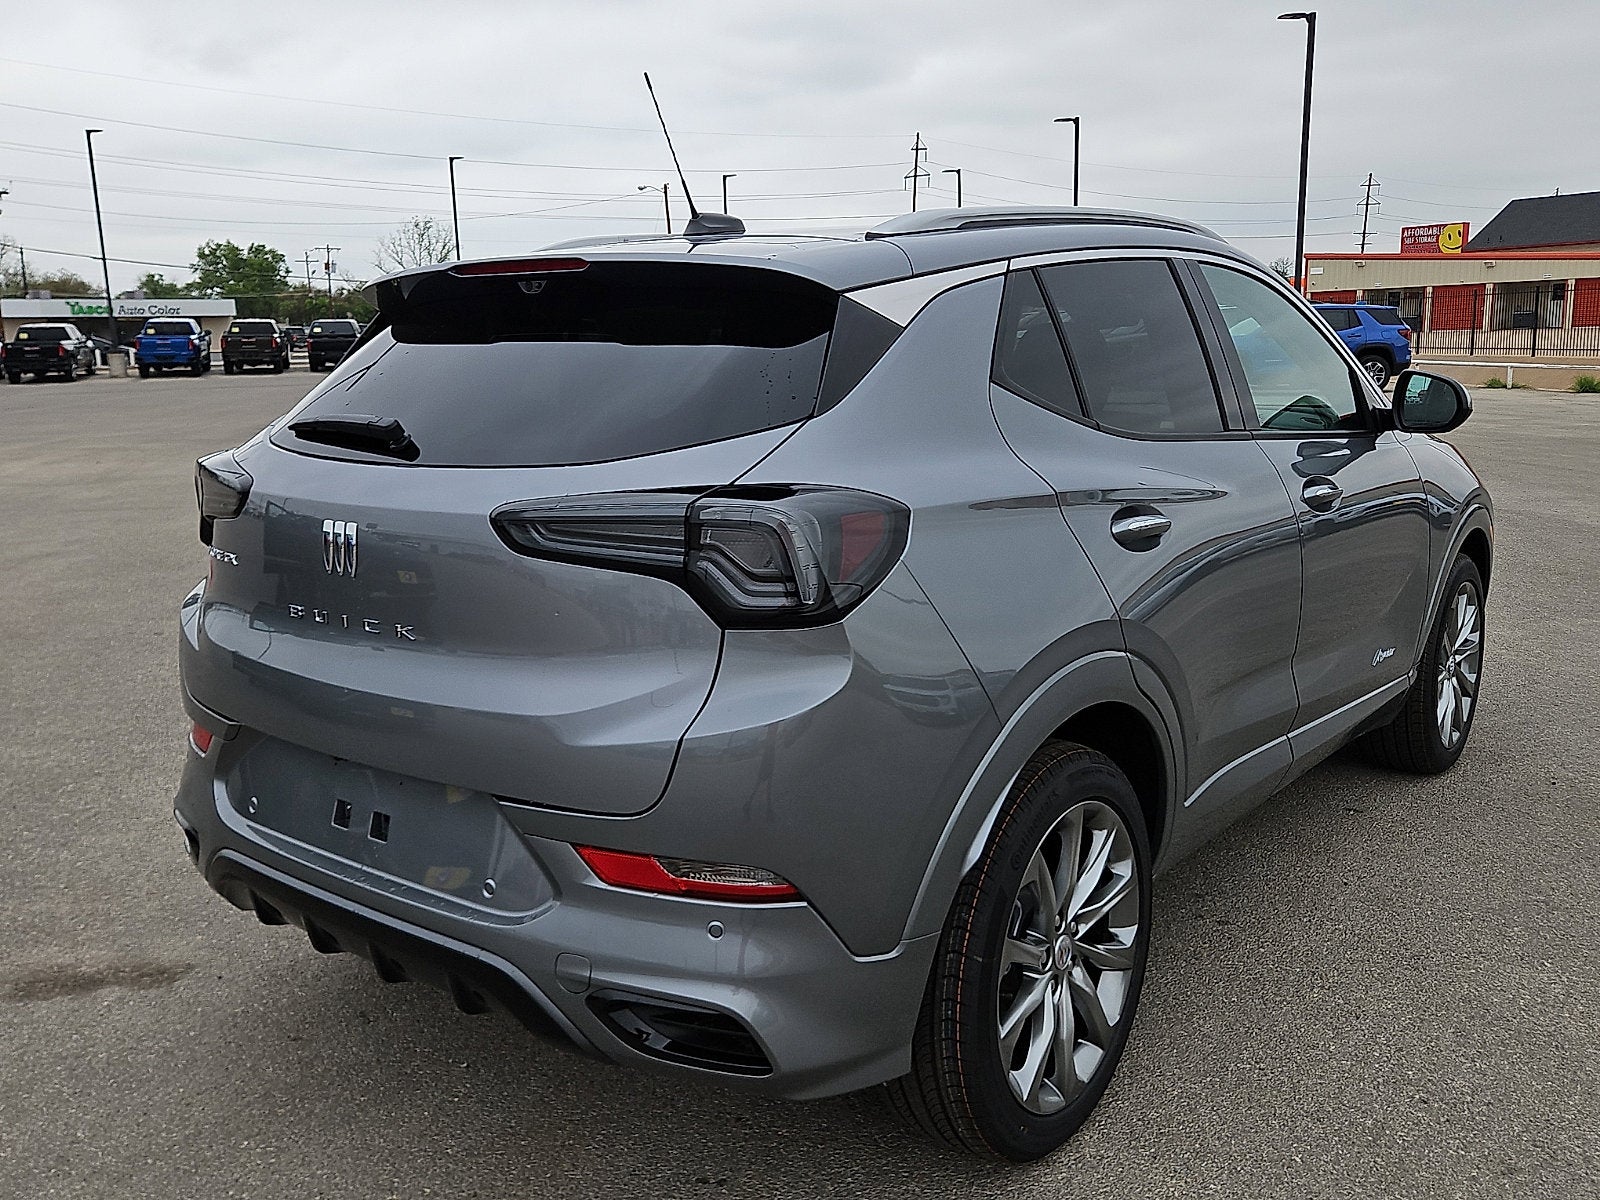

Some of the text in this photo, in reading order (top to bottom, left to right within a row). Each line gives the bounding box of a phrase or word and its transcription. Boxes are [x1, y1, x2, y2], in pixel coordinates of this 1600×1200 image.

[1403, 226, 1445, 237] AFFORDABLE
[1404, 236, 1437, 245] SELF STORAGE
[118, 305, 146, 315] Auto
[148, 304, 180, 315] Color
[288, 603, 416, 641] BUICK
